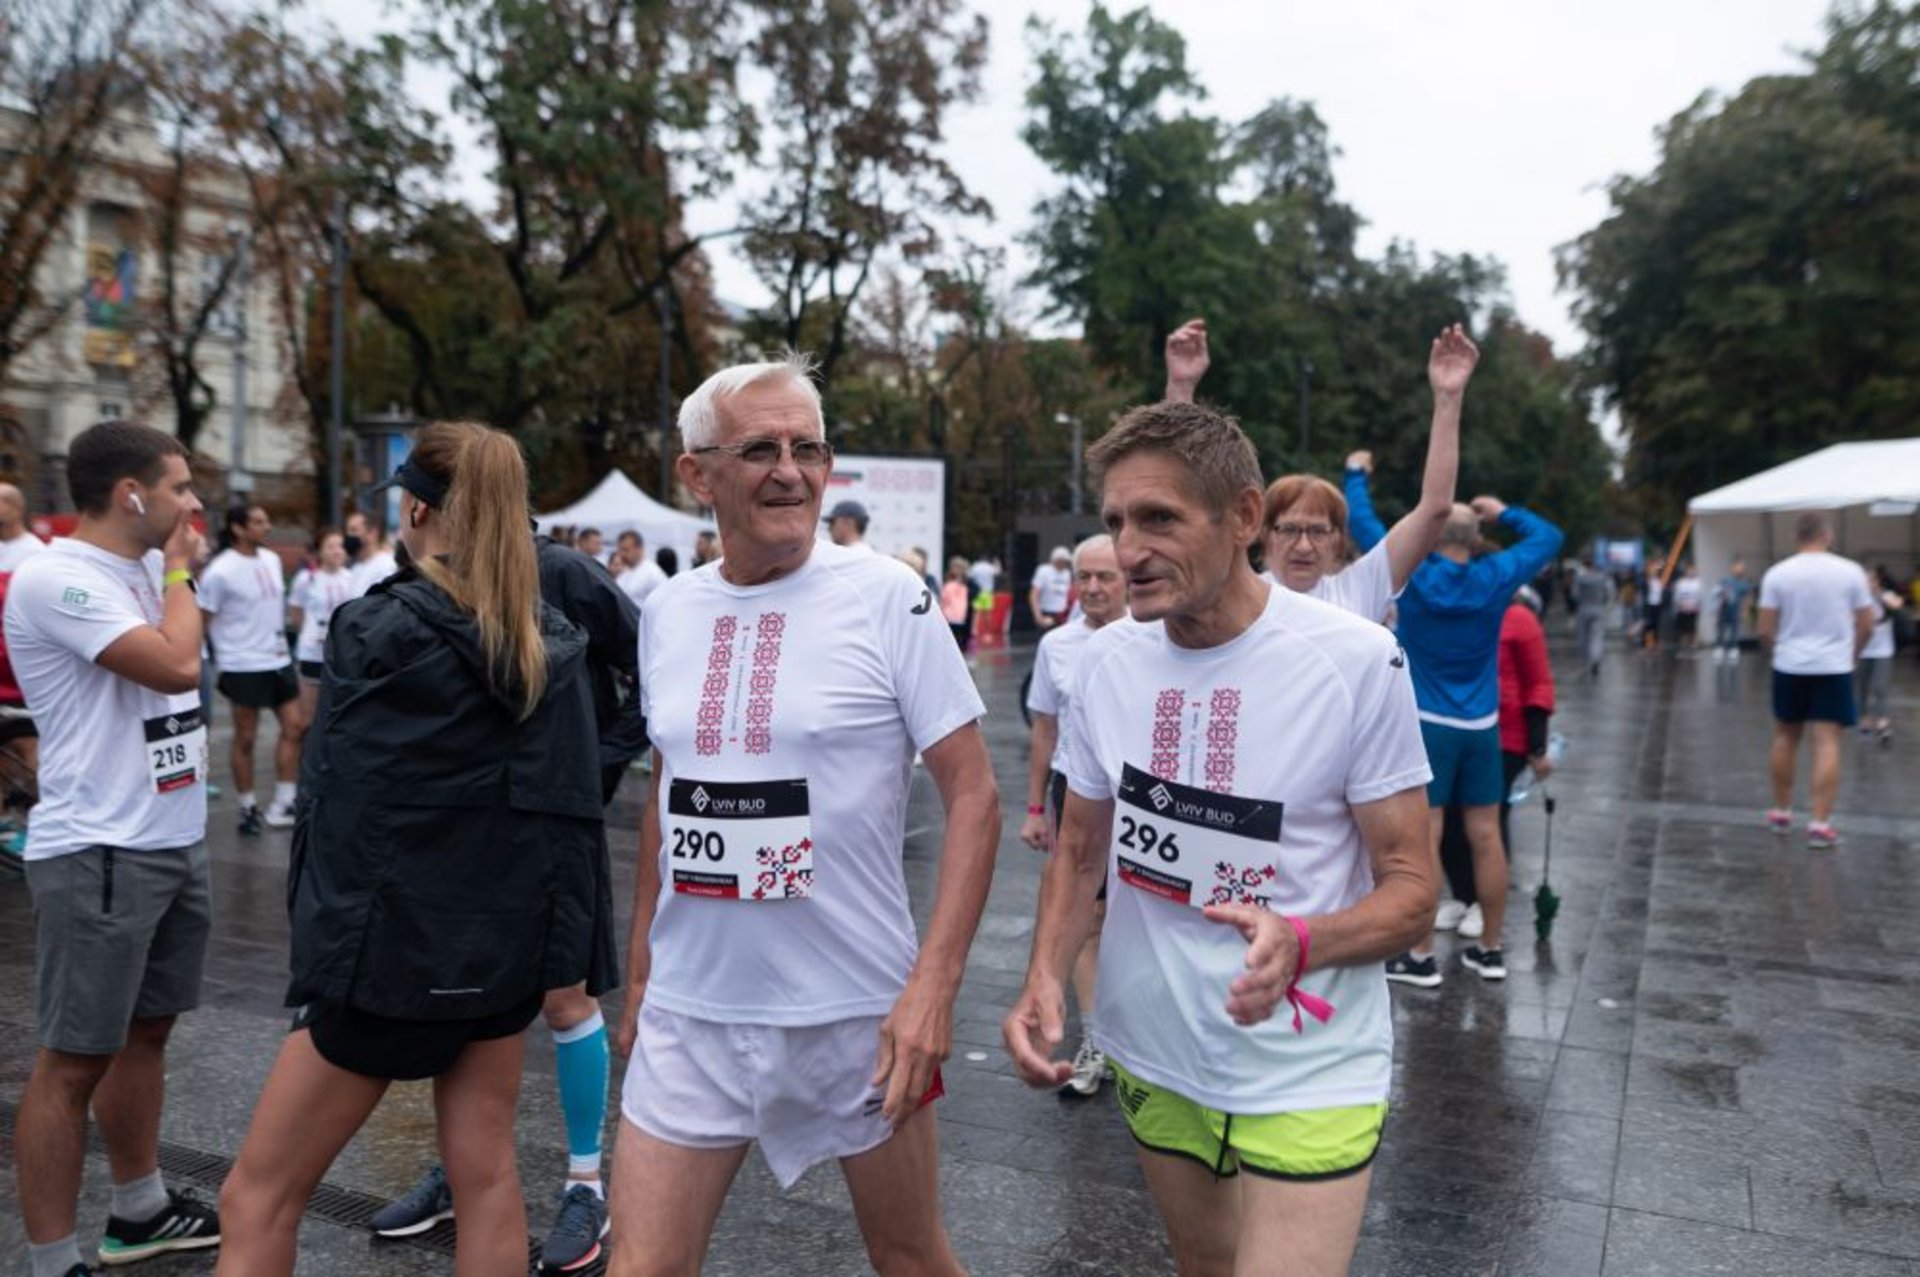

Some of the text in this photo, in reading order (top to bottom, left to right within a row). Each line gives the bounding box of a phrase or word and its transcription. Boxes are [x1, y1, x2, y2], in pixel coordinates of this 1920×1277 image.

[153, 744, 187, 769] 218
[711, 798, 766, 811] LVIV BUD
[1175, 801, 1203, 816] LVIV
[1205, 807, 1236, 824] BUD
[672, 827, 725, 862] 290
[1118, 815, 1180, 863] 296
